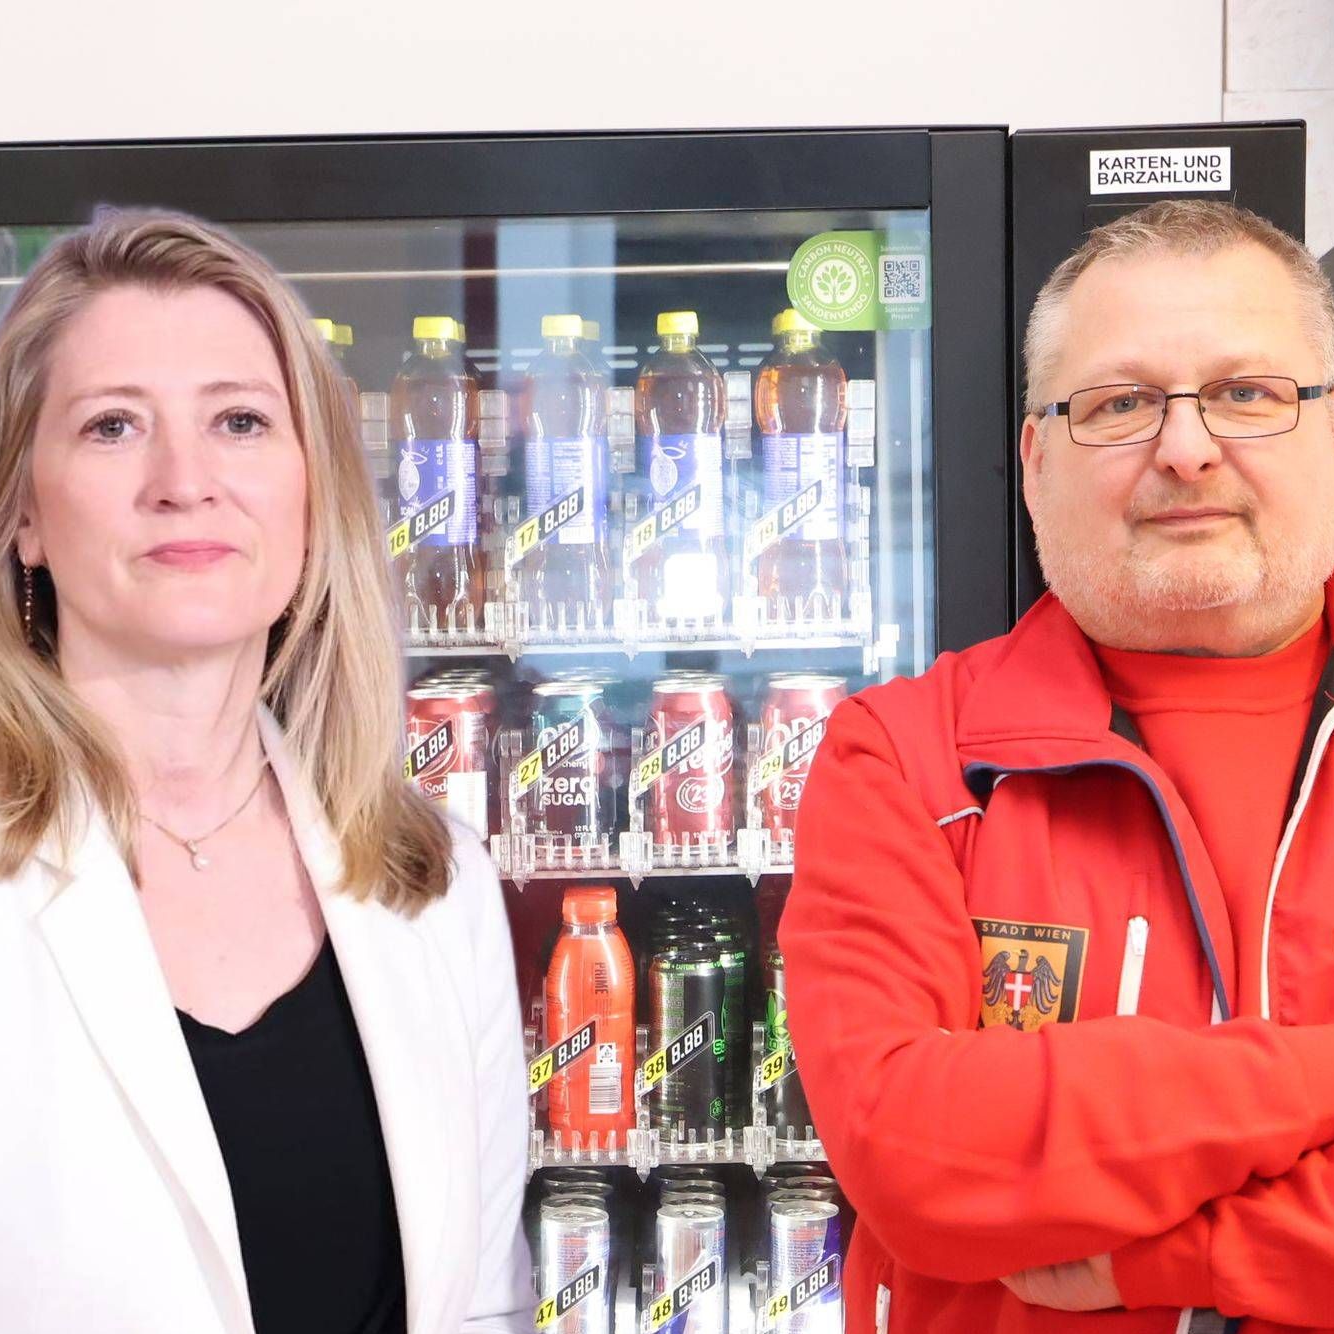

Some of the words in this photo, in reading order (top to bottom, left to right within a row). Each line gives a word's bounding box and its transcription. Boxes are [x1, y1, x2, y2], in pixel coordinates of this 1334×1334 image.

[1097, 169, 1223, 186] BARZAHLUNG
[1098, 156, 1179, 171] KARTEN-
[1184, 154, 1222, 168] UND
[798, 244, 832, 279] CARBON
[833, 243, 871, 276] NEUTRAL
[801, 293, 869, 321] SANDENVENDO
[389, 528, 406, 549] 16
[415, 496, 450, 536] 8.88
[519, 524, 536, 548] 17
[544, 492, 579, 534] 8.88
[635, 523, 653, 546] 18
[661, 490, 696, 532] 8.88
[783, 485, 818, 529] 8.88
[417, 726, 448, 771] 8.88
[520, 761, 539, 783] 27
[546, 725, 580, 768] 8.88
[640, 757, 660, 783] 28
[668, 725, 701, 766] 8.88
[761, 755, 781, 780] 29
[788, 722, 824, 763] 8.88
[425, 778, 449, 796] Sod
[981, 922, 1028, 936] STADT
[1033, 927, 1072, 940] WIEN
[594, 961, 609, 995] PRIME
[530, 1058, 552, 1086] 37
[558, 1025, 591, 1066] 8.88
[645, 1054, 665, 1082] 38
[671, 1024, 703, 1065] 8.88
[763, 1054, 784, 1082] 39
[536, 1302, 555, 1326] 47
[562, 1275, 595, 1308] 8.88
[651, 1298, 672, 1323] 48
[678, 1267, 711, 1307] 8.88
[769, 1295, 789, 1318] 49
[796, 1265, 829, 1305] 8.88
